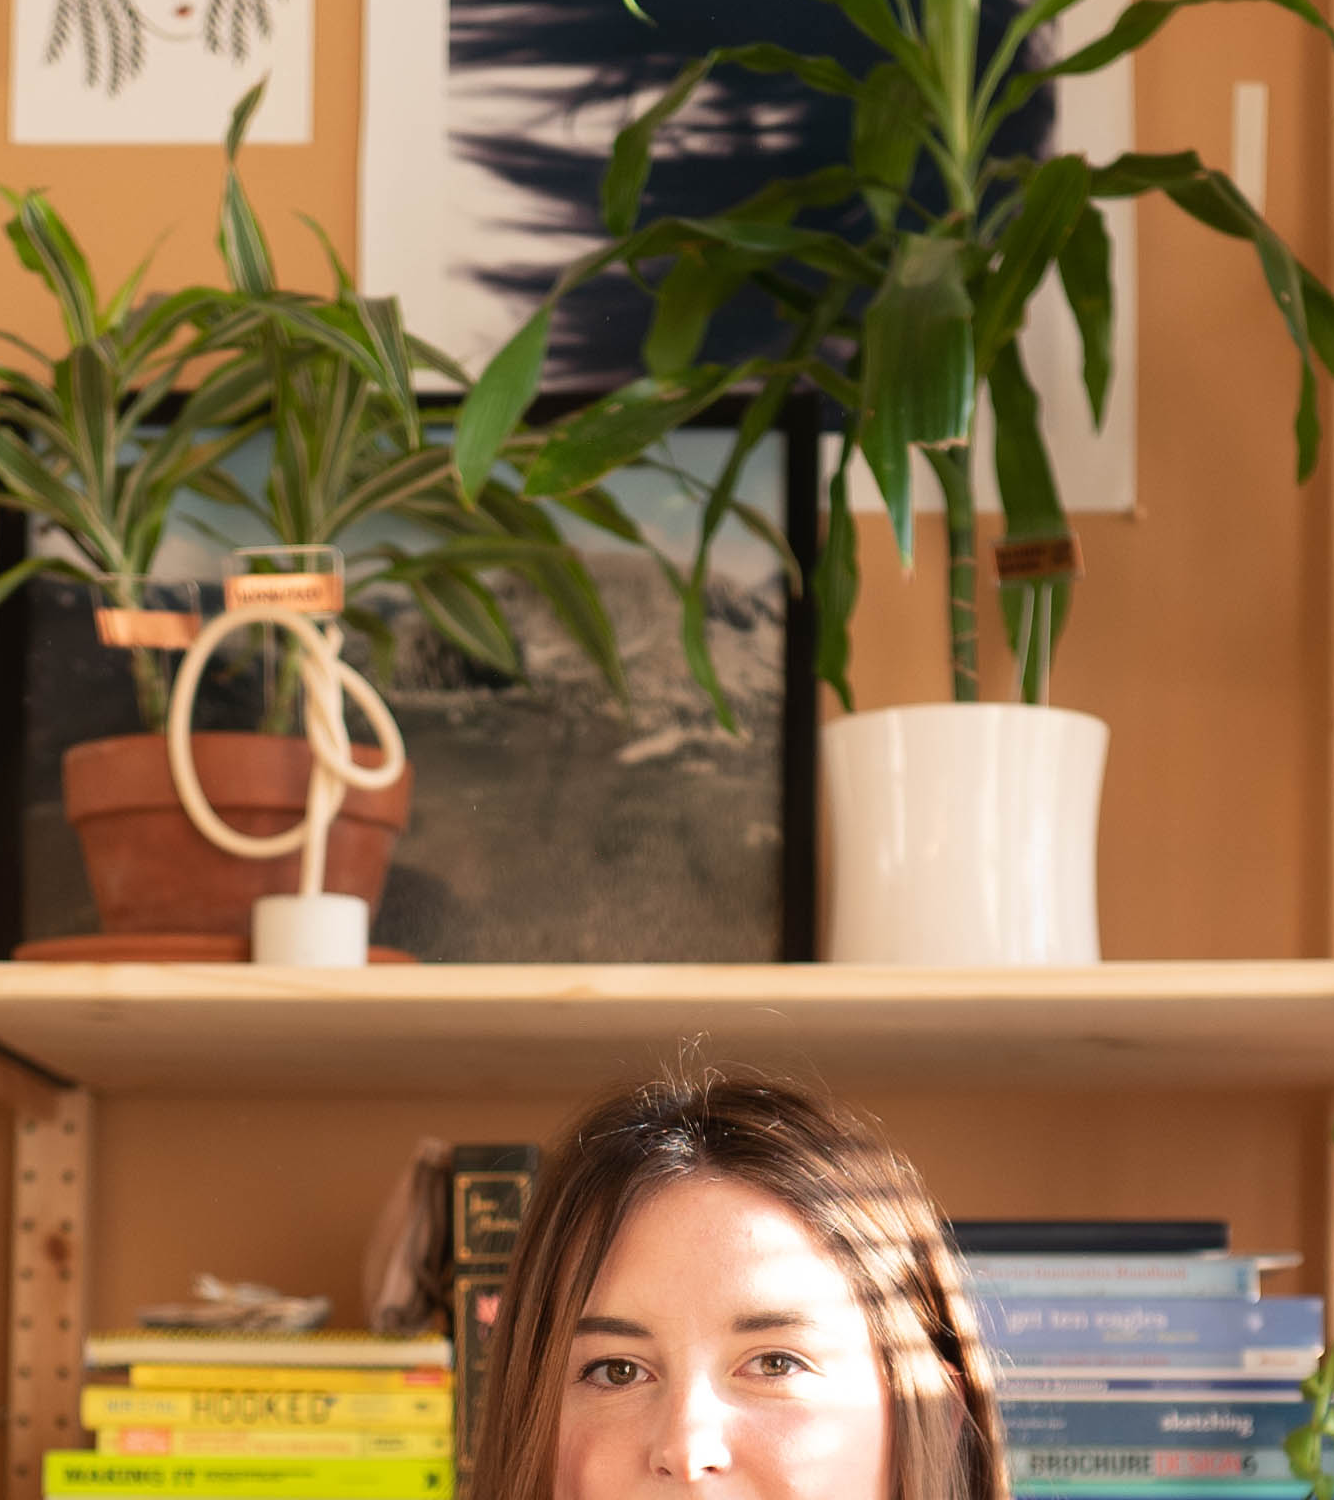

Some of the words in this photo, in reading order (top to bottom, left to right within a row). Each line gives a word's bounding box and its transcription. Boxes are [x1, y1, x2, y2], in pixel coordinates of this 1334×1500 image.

[1051, 1309, 1088, 1328] ten
[1095, 1306, 1168, 1331] eagles
[190, 1389, 331, 1426] HOOKED
[1160, 1412, 1254, 1437] sketching
